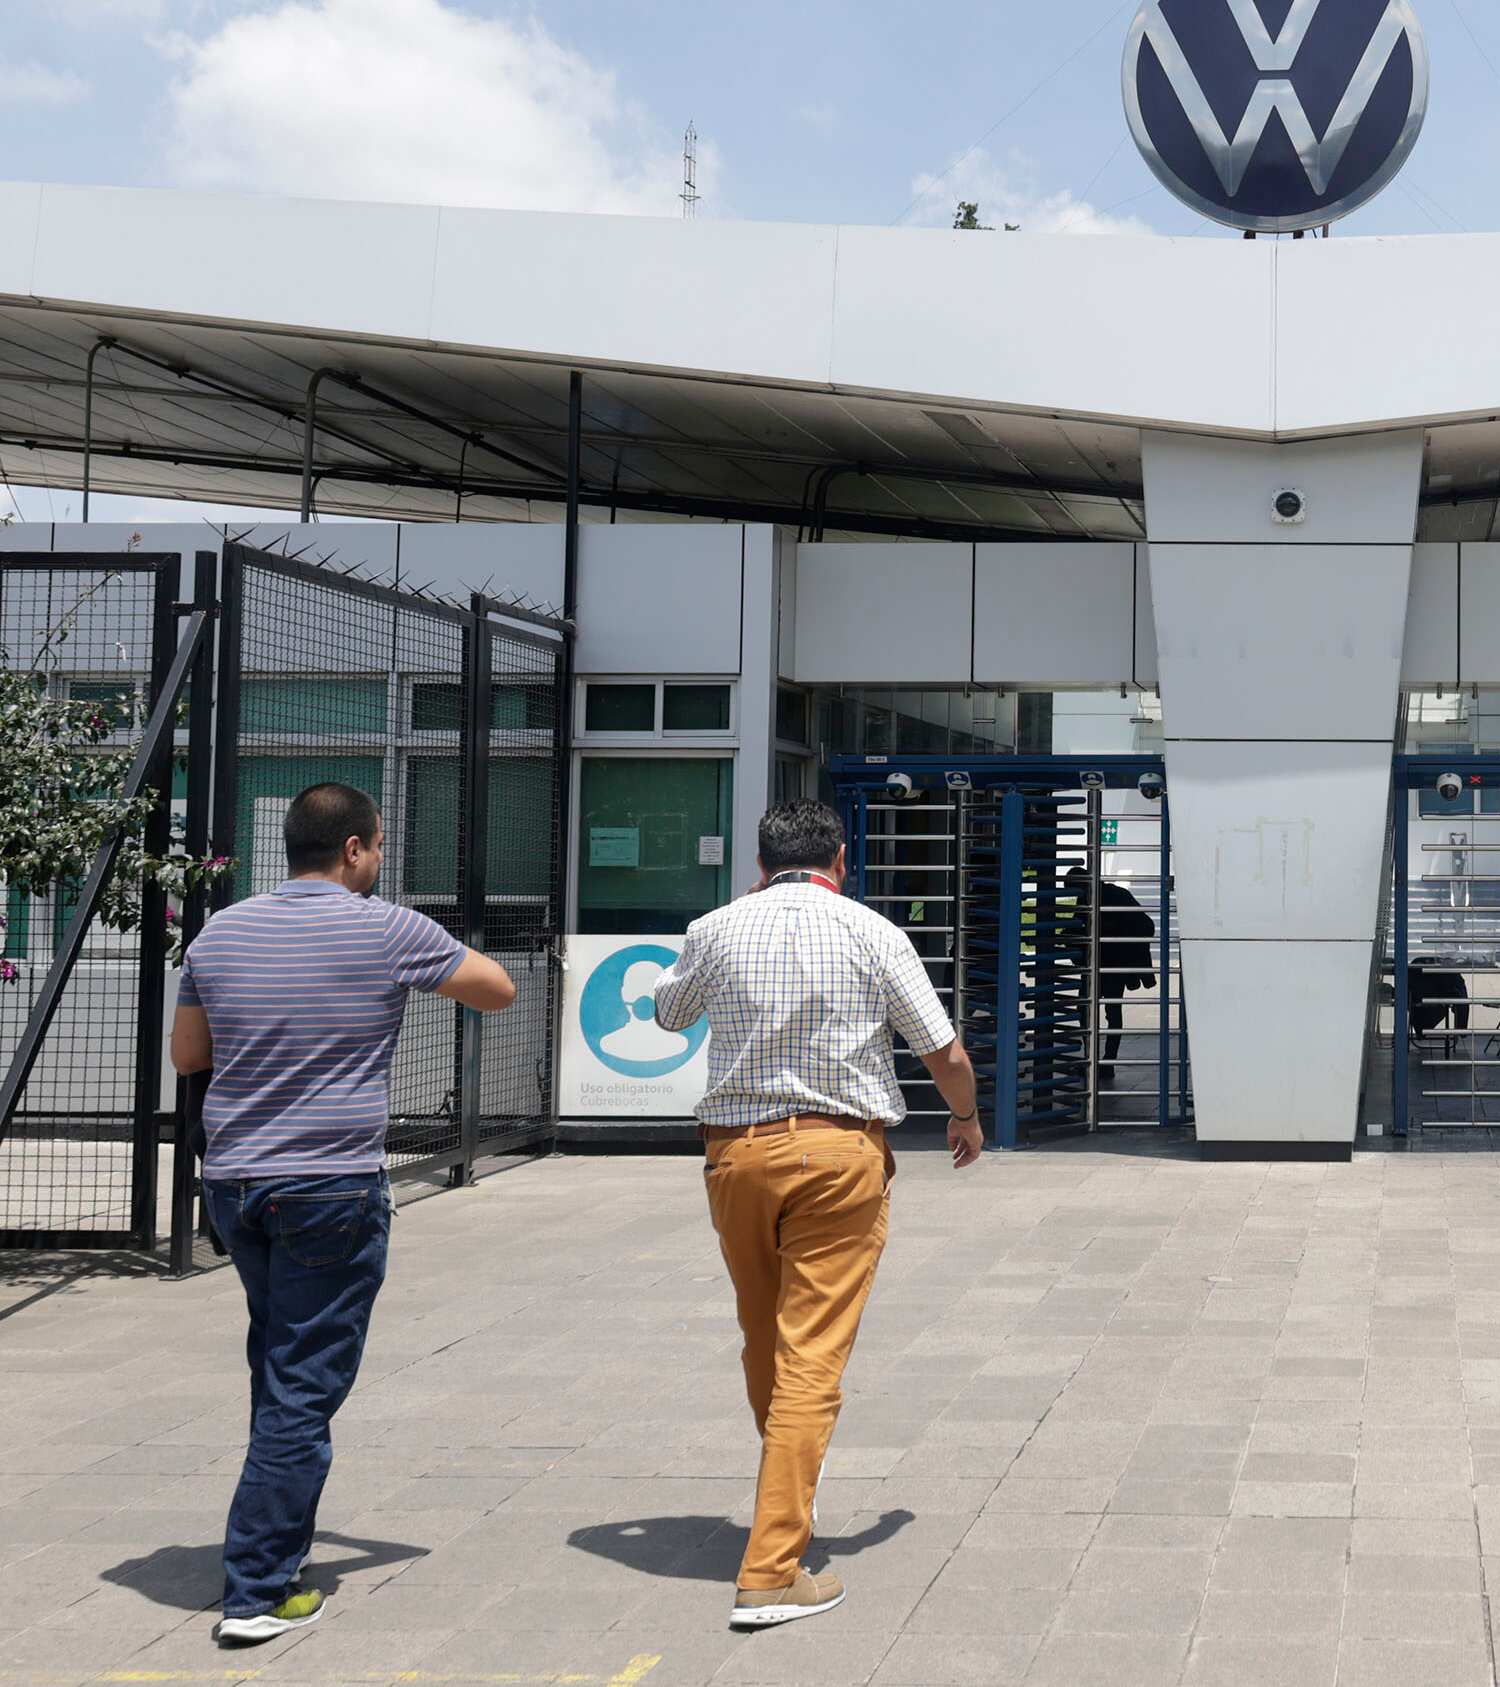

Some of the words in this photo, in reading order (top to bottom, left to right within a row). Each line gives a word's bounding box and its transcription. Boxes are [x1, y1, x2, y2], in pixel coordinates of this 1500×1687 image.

[1136, 0, 1412, 198] VW
[580, 1082, 603, 1094] Uso
[607, 1082, 674, 1096] obligatorio
[580, 1095, 649, 1106] Cubrebocas
